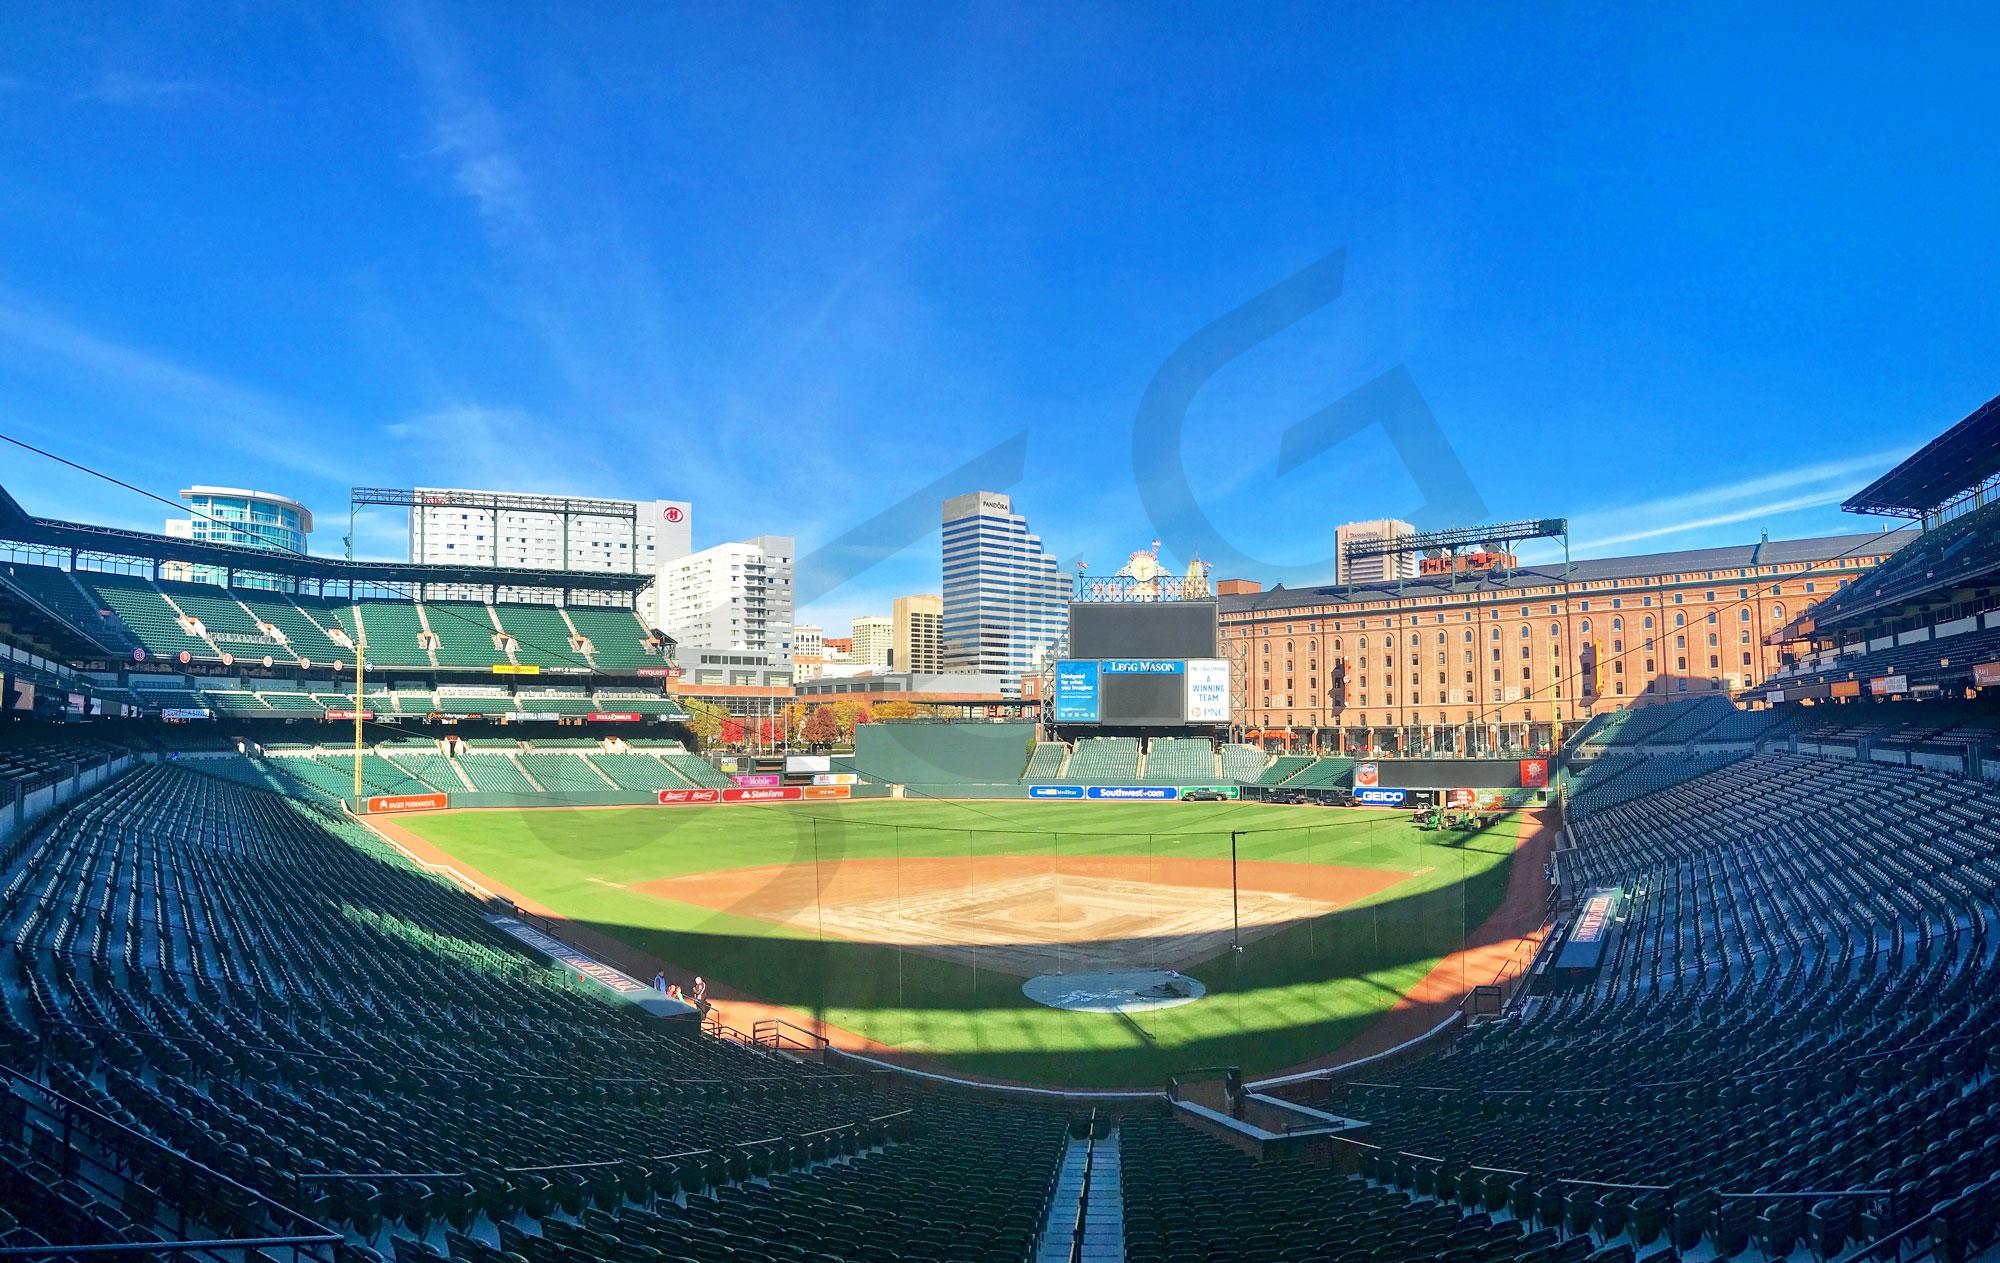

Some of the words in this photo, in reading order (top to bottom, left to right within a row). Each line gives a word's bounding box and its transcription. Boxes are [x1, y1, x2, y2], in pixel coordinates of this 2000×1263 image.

[1112, 662, 1138, 672] LEGG
[1141, 662, 1175, 672] MASON
[1193, 684, 1225, 692] WINNING
[1199, 693, 1219, 702] TEAM
[1203, 707, 1226, 717] PNC
[1363, 791, 1404, 802] GEICO
